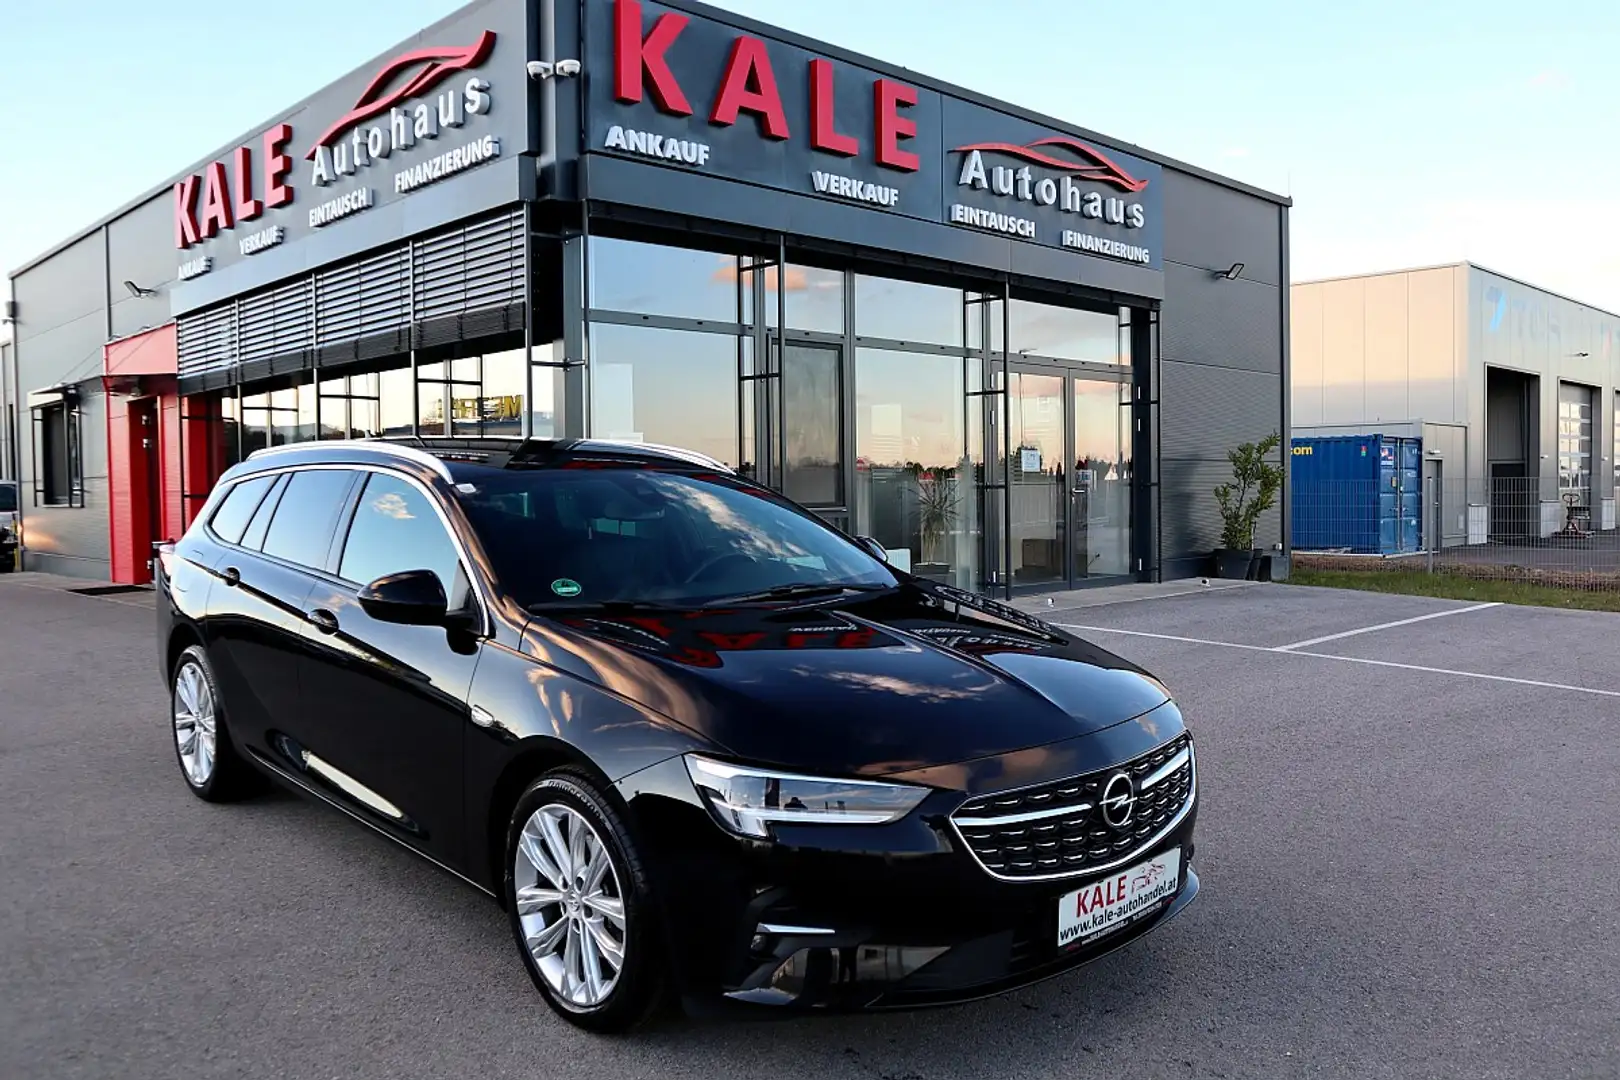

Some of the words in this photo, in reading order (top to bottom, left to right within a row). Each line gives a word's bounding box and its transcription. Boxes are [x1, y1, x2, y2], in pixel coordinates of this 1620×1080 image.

[310, 77, 491, 187] Autohaus
[614, 0, 919, 173] KALE
[173, 123, 293, 250] KALE
[239, 224, 284, 256] VERKAUF
[308, 187, 374, 228] EINTAUSCH
[394, 134, 499, 194] FINANZIERUNG
[604, 125, 710, 166] ANKAUF
[811, 170, 899, 207] VERKAUF
[950, 203, 1036, 238] EINTAUSCH
[1062, 229, 1150, 264] FINANZIERUNG
[957, 149, 1145, 228] Autohaus
[1291, 445, 1313, 456] om
[1059, 877, 1176, 941] www.kale-autohandel.at
[1076, 875, 1127, 918] KALE
